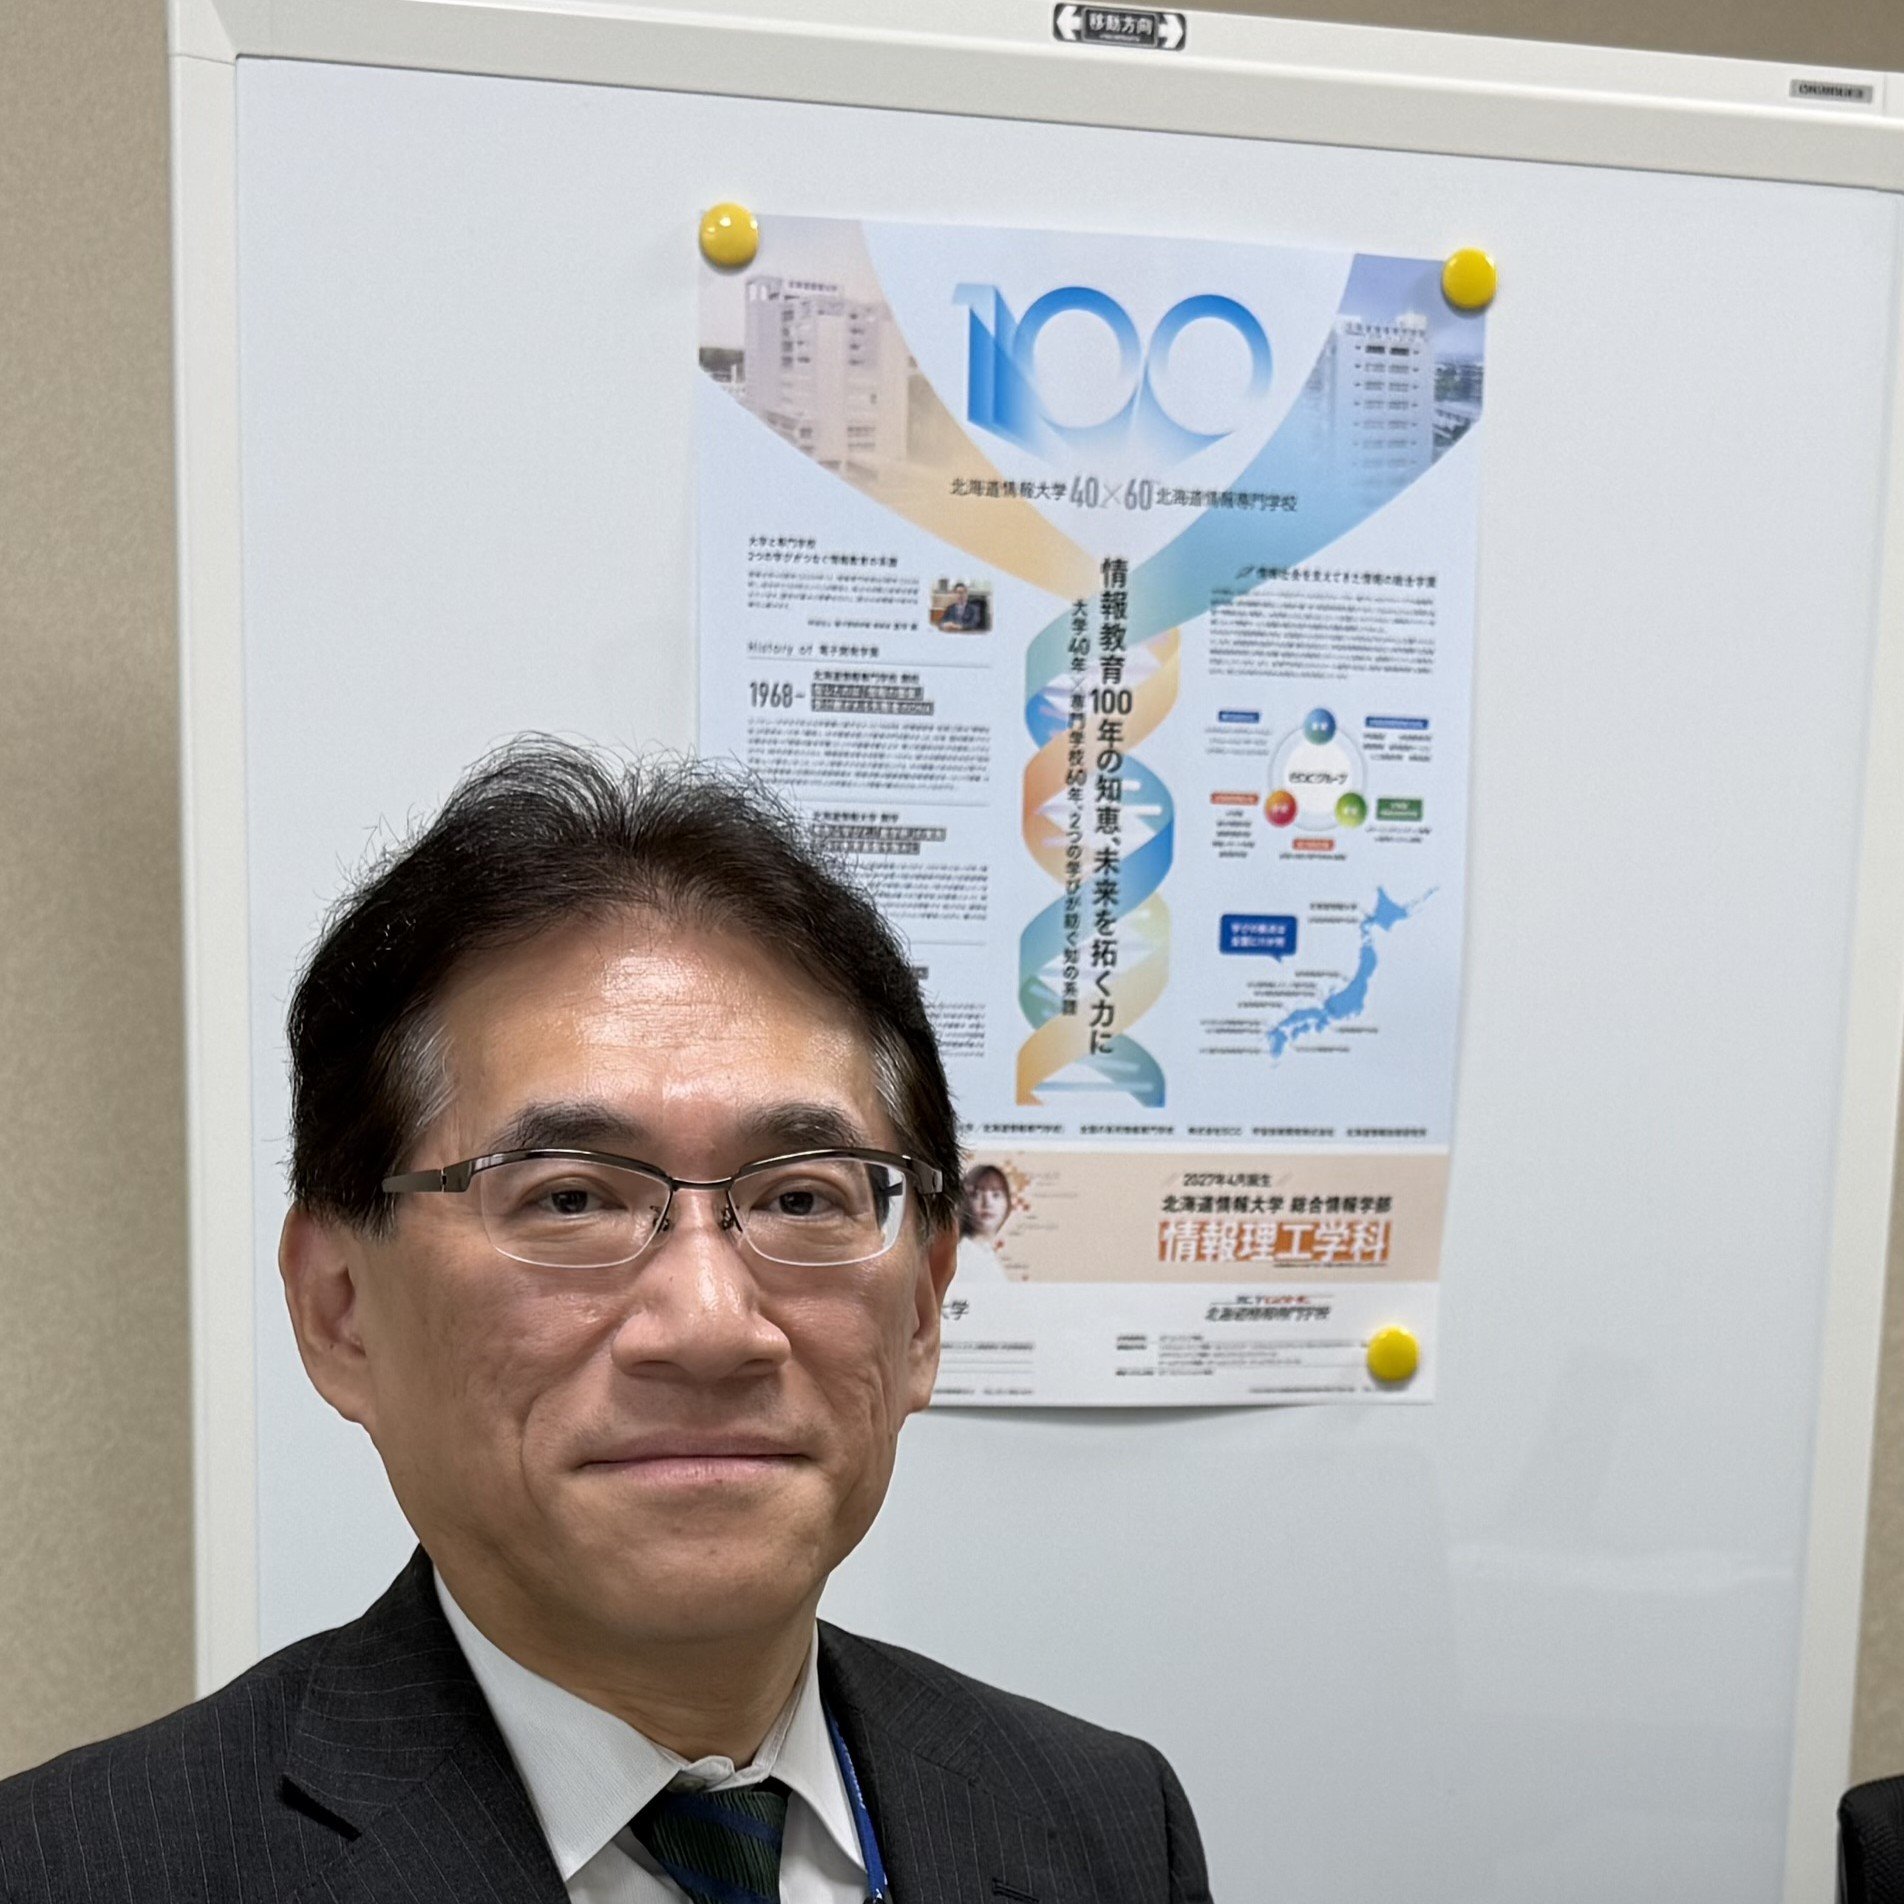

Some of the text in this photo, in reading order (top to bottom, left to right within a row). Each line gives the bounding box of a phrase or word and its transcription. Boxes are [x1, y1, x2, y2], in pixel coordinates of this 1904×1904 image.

[950, 282, 1274, 437] 100
[1088, 558, 1133, 1056] 情報教育100年の知恵、未来を拓く力に
[1162, 1195, 1284, 1214] 北海道情報大学
[1162, 1219, 1389, 1264] 情報理工学科
